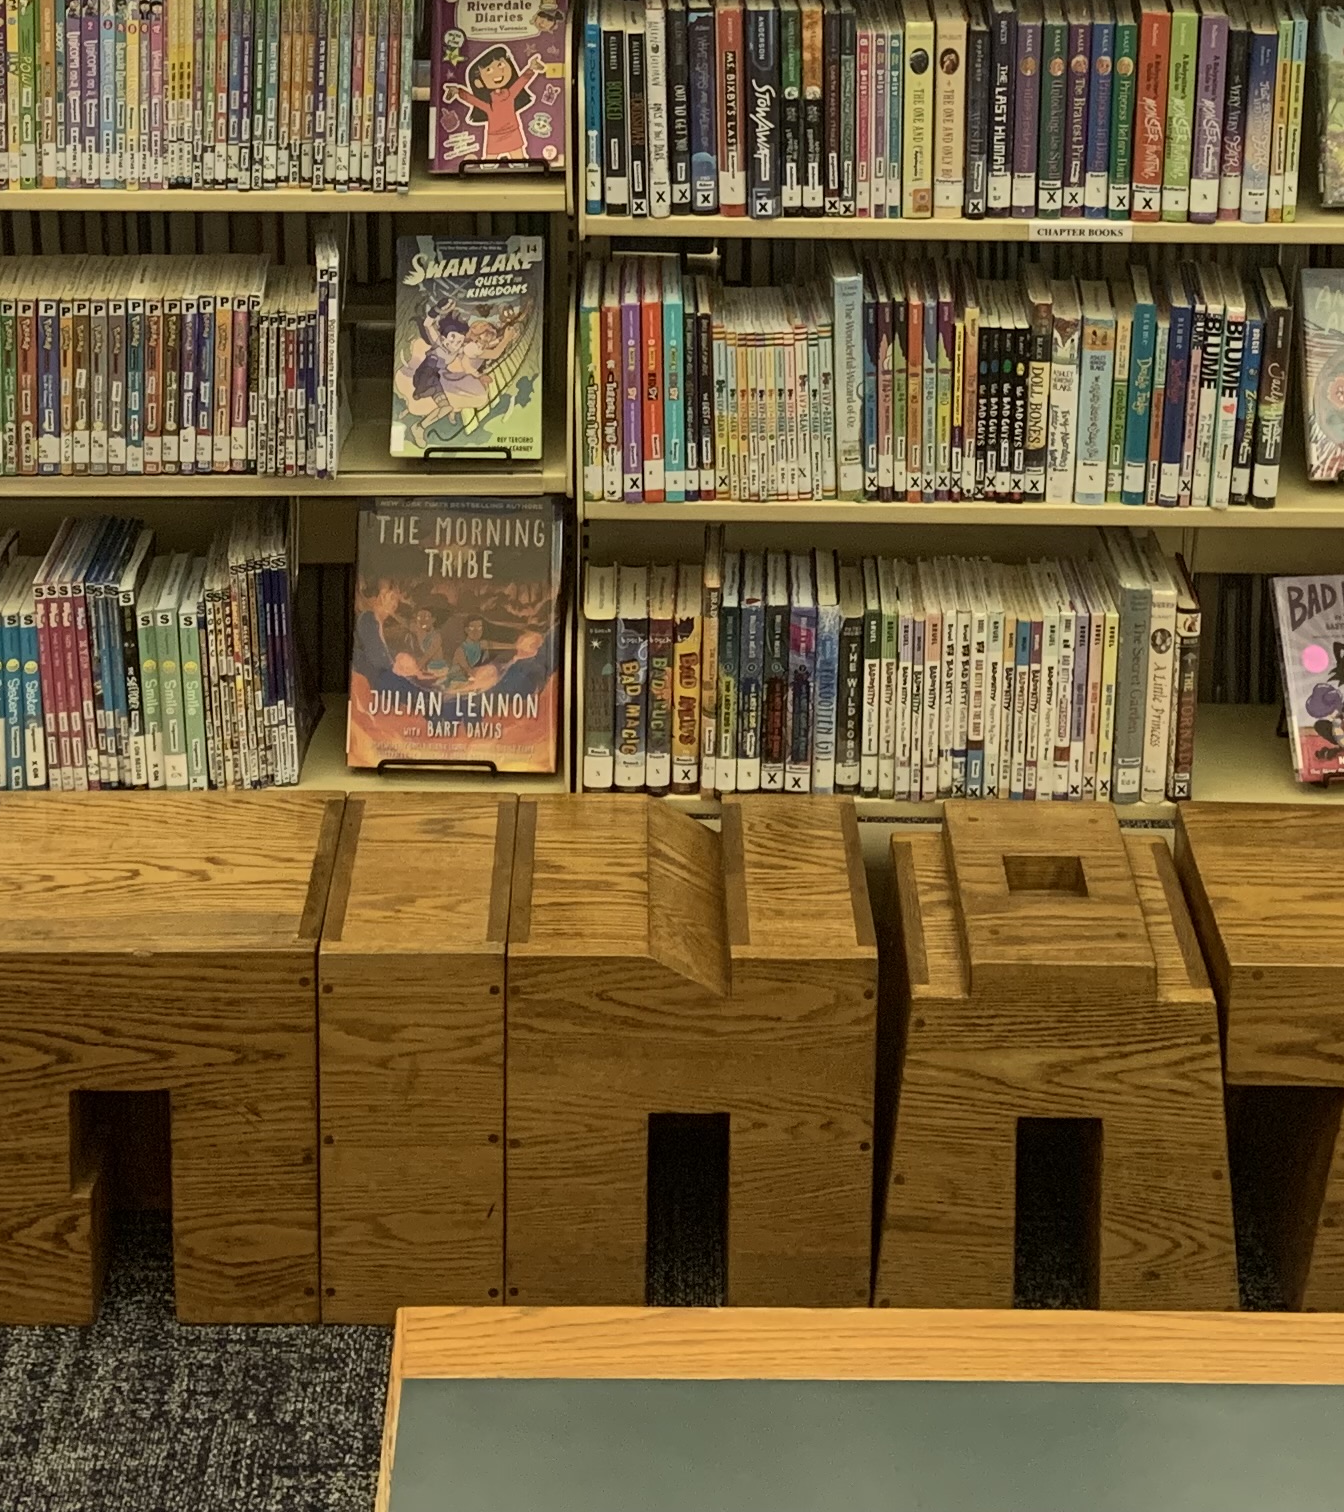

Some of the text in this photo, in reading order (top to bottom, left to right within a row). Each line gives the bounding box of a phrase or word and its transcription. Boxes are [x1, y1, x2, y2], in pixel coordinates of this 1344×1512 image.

[467, 0, 532, 12] Riverdale
[475, 12, 524, 24] Diaries
[758, 16, 766, 60] ANDERSON
[725, 52, 736, 151] MS. BIXBY'S LAST
[992, 65, 1008, 174] THE LAST HUMAN
[1037, 227, 1124, 238] CHAPTER BOOKS
[403, 252, 477, 286] SWAN
[474, 274, 514, 287] QUEST
[466, 283, 528, 299] KINGDOMS
[1201, 318, 1223, 389] BLUME
[1027, 366, 1044, 444] DOLL BONES
[376, 515, 546, 548] THE MORNING
[424, 548, 494, 579] TRIBE
[1286, 583, 1338, 632] BAD
[145, 679, 158, 714] Smile
[368, 689, 539, 720] JULIAN LENNON
[619, 659, 641, 755] BAD MAGIC
[427, 720, 460, 738] BART
[467, 721, 503, 739] DAVIS
